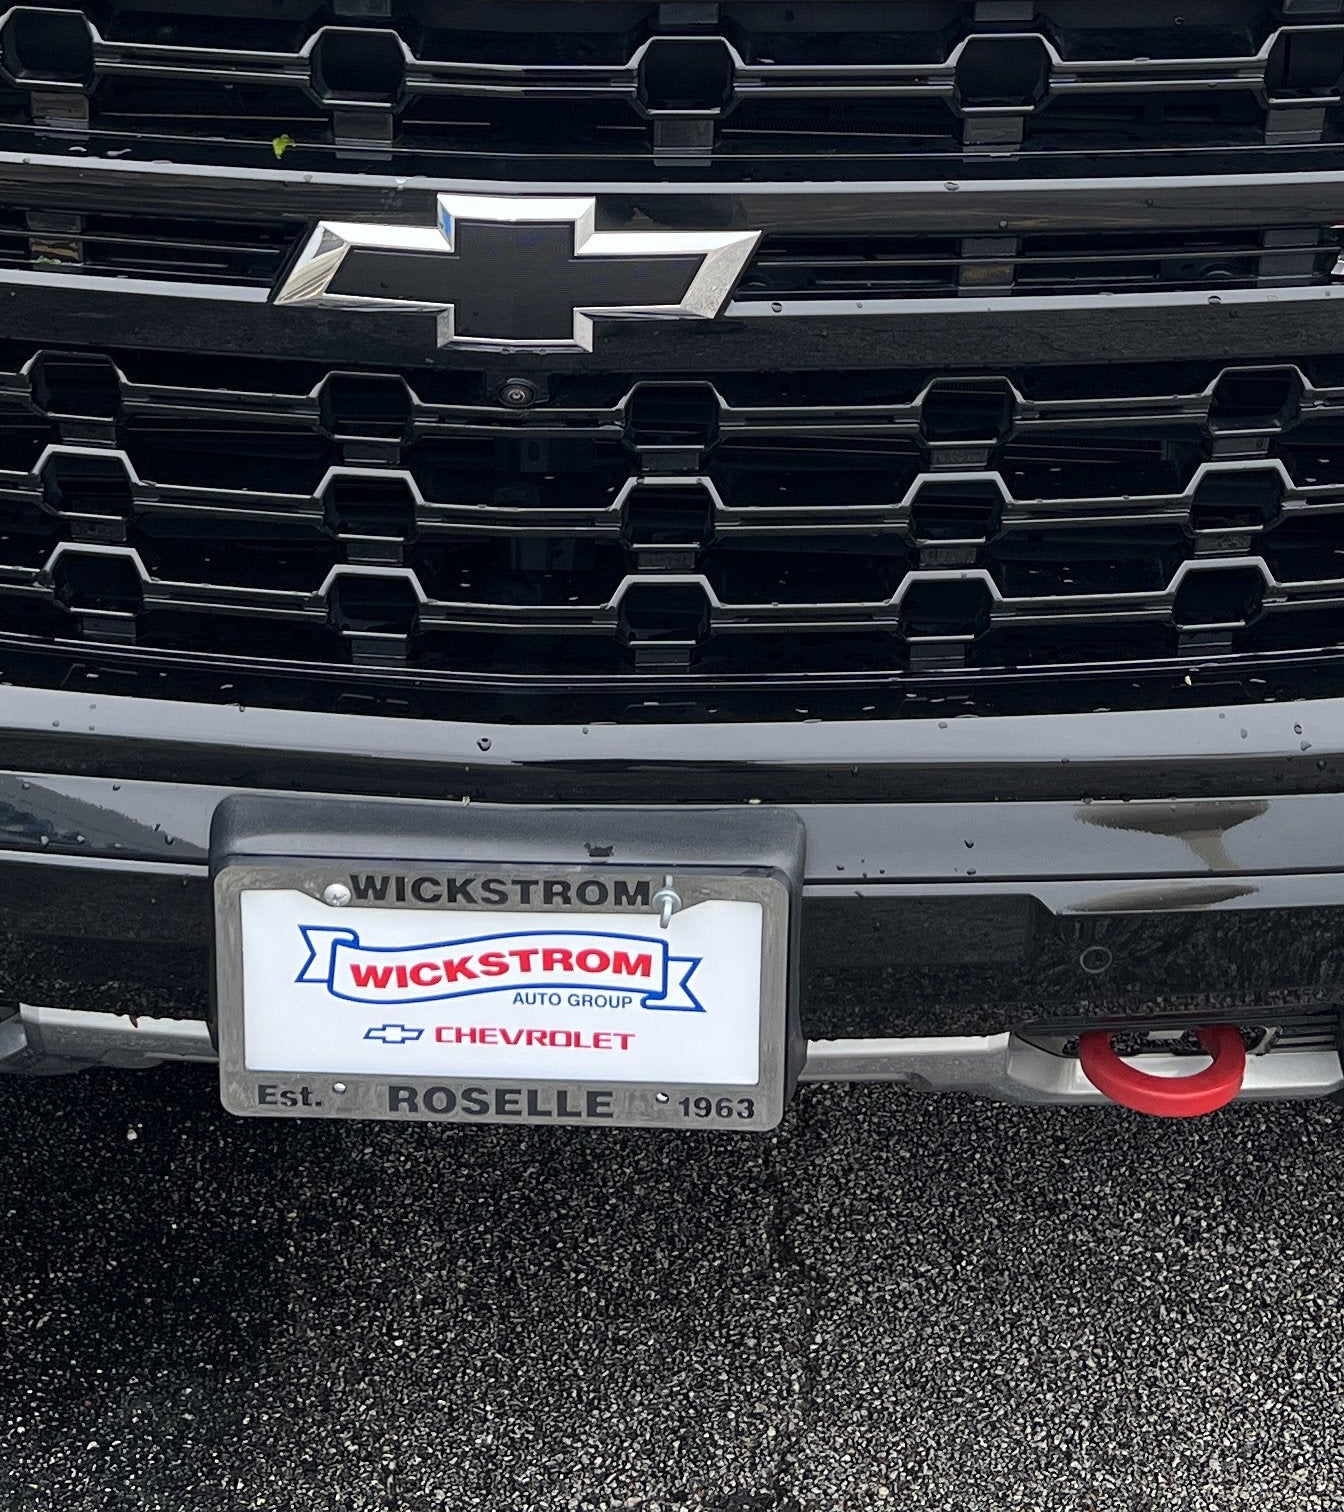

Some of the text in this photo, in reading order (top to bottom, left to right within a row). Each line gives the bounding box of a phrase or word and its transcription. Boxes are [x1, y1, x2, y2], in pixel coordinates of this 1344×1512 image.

[349, 874, 650, 907] WICKSTROM
[349, 948, 653, 989] WICKSTROM
[512, 991, 633, 1009] AUTO GROUP
[434, 1025, 637, 1050] CHEVROLET
[257, 1084, 756, 1120] Est. ROSELLE 1963
